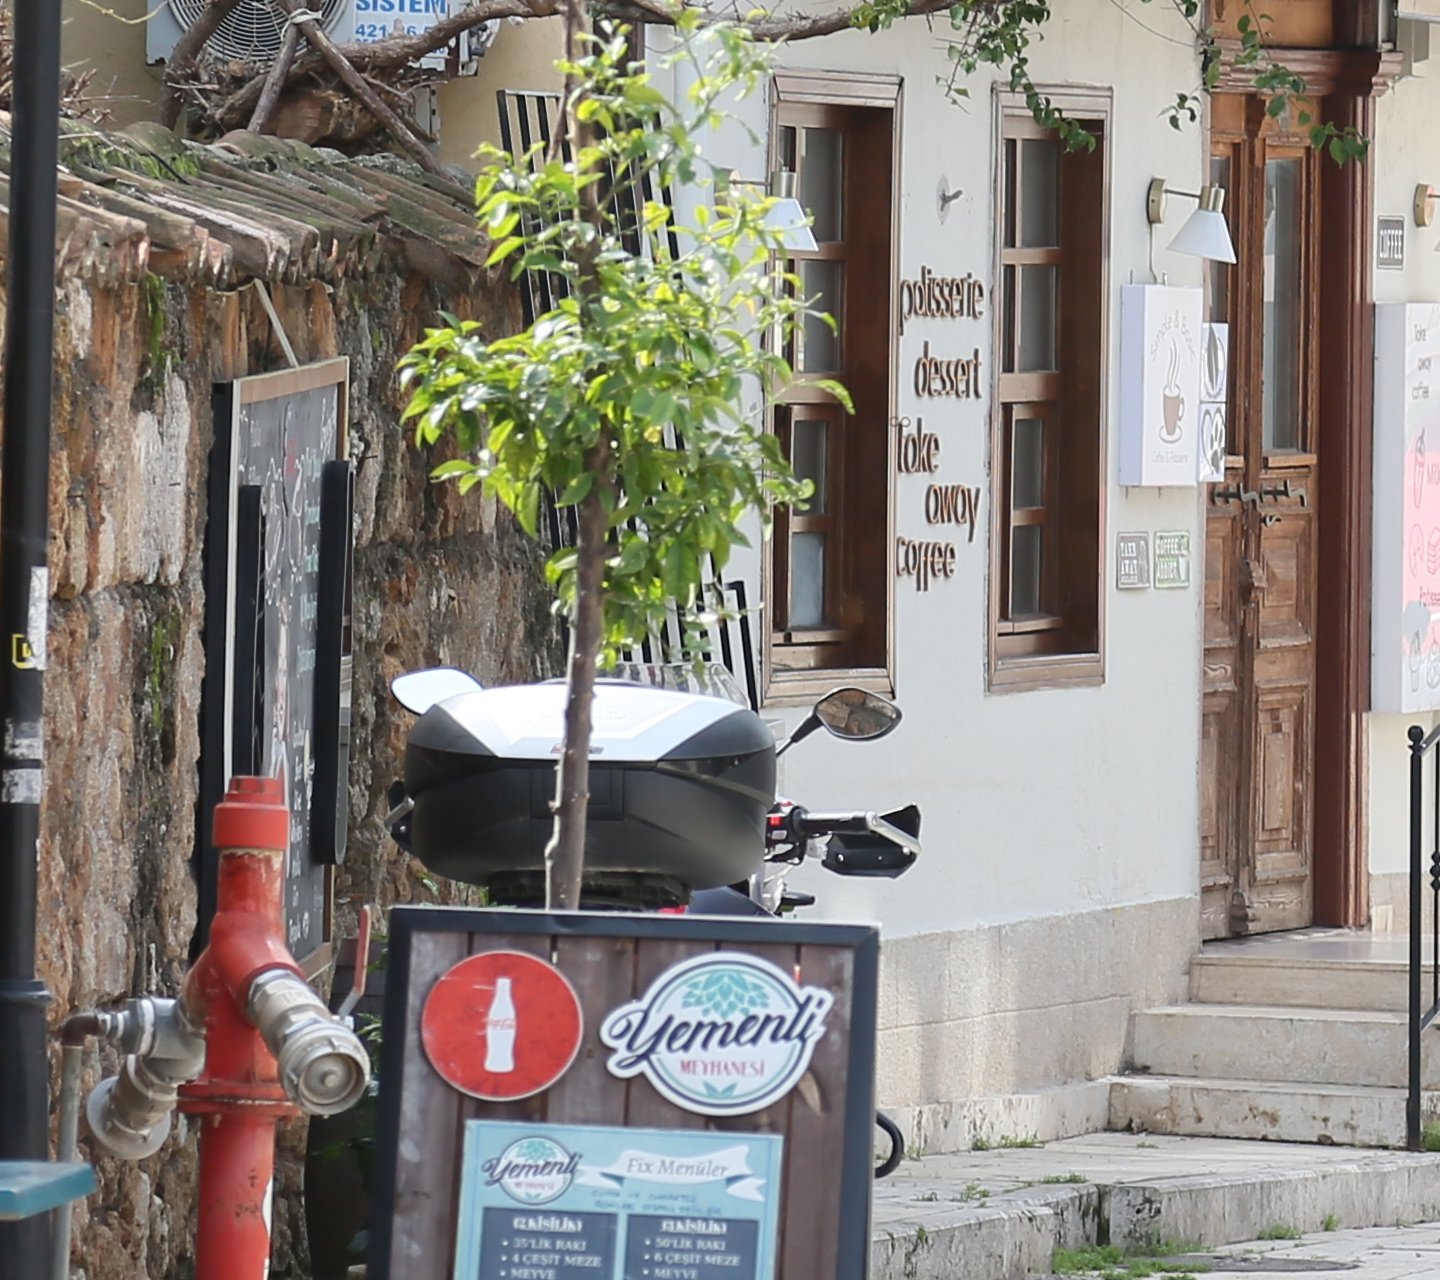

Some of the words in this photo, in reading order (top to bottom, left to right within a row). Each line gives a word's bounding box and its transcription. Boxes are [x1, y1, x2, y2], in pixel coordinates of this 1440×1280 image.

[355, 24, 387, 38] 421
[1380, 228, 1403, 260] COFFEE
[899, 265, 984, 336] patisserie
[914, 340, 982, 399] dessert
[897, 417, 940, 473] take
[925, 484, 980, 543] away
[896, 535, 956, 592] coffee
[608, 994, 826, 1070] Yemenli
[679, 1056, 766, 1078] MEYHANESİ
[481, 1152, 584, 1188] Yemenli
[626, 1158, 655, 1175] Fix
[657, 1158, 729, 1178] Menüler
[511, 1268, 557, 1280] MEYVE
[565, 1255, 602, 1268] MEZE
[654, 1267, 699, 1280] MEYVE
[704, 1255, 741, 1267] MEZE
